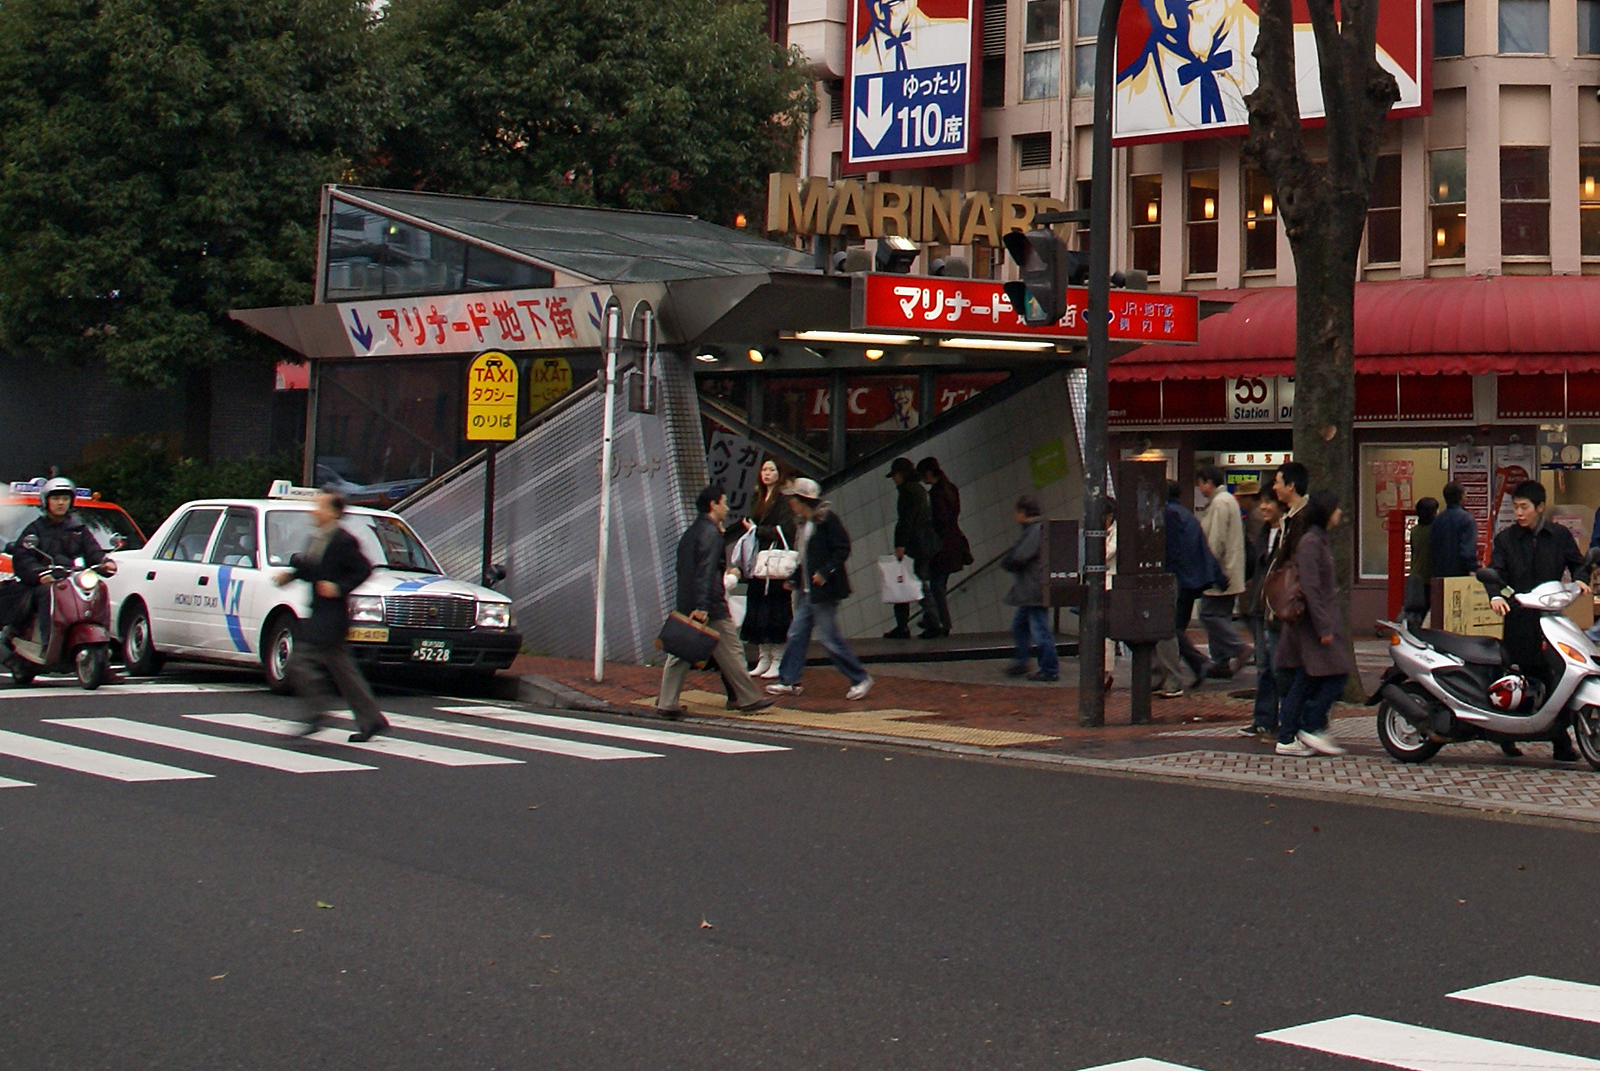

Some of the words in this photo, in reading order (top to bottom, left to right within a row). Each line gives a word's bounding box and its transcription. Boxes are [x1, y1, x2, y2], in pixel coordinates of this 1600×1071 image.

[903, 69, 961, 100] ゆったり
[897, 102, 963, 148] 110席
[376, 295, 579, 348] マリナード地下街
[474, 368, 514, 384] TAXI
[472, 387, 515, 402] タクシー
[472, 413, 513, 428] のりば
[1233, 406, 1270, 420] Station
